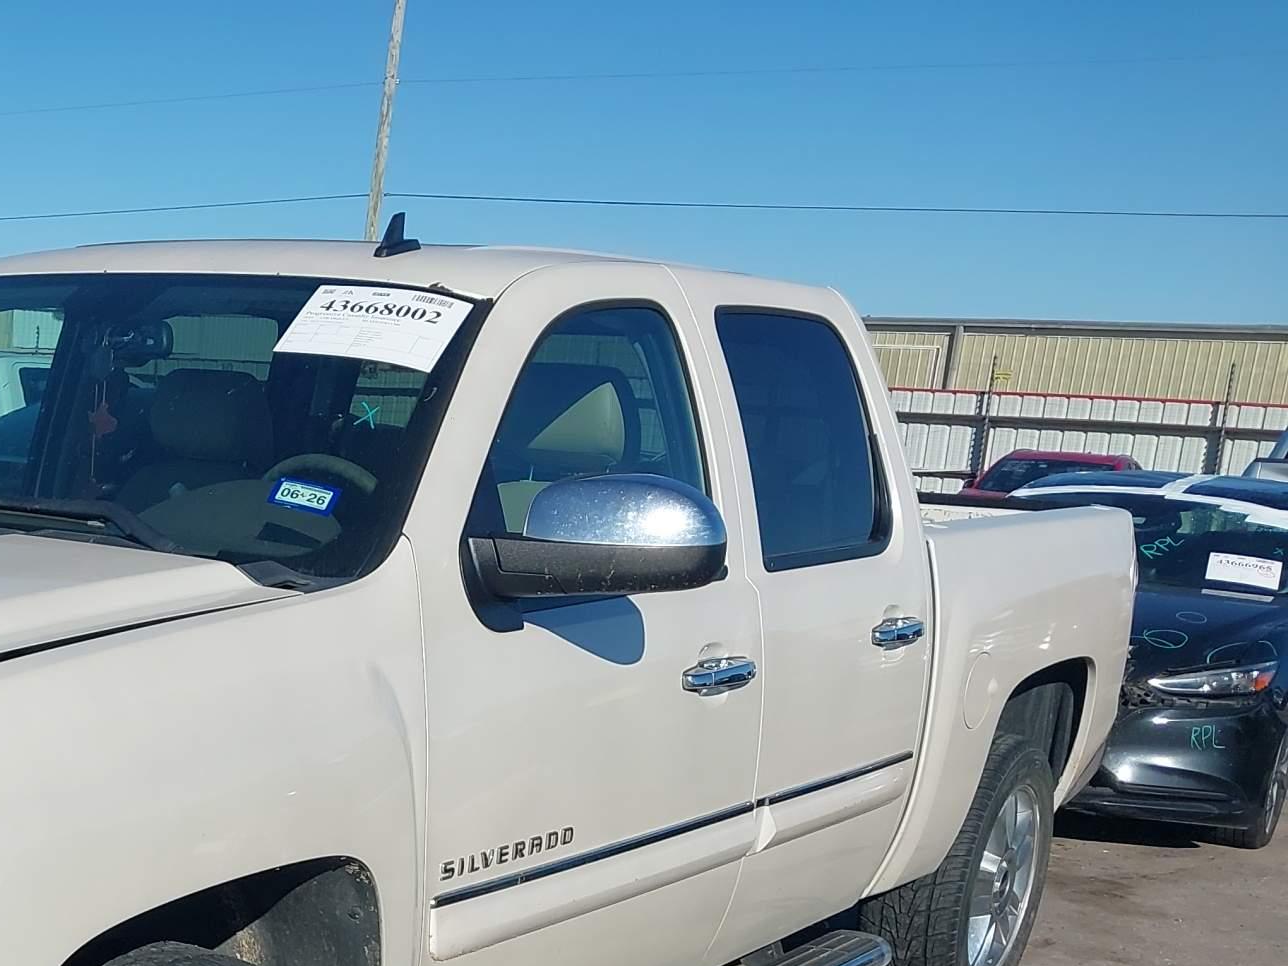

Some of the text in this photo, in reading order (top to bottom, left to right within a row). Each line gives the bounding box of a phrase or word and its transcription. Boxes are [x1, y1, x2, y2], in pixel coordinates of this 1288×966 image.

[320, 299, 442, 325] 43668002
[1140, 536, 1185, 560] RPL
[1190, 724, 1226, 751] RPL
[440, 826, 576, 881] SILVERADO
